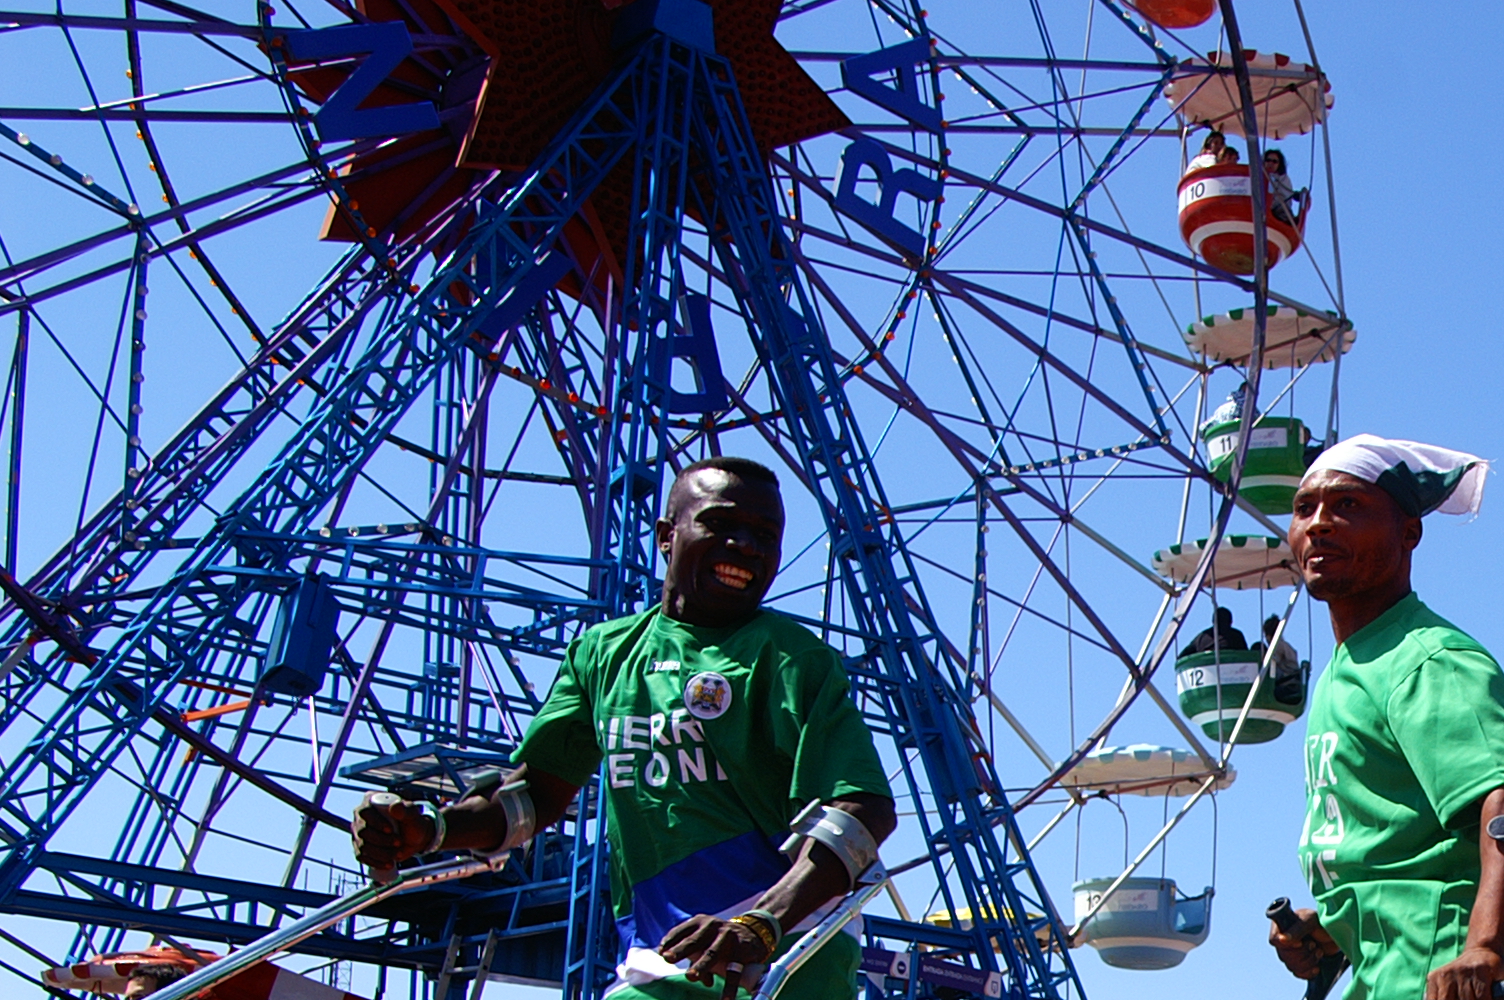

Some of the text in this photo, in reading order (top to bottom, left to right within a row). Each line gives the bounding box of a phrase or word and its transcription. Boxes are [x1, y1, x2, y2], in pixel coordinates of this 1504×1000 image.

[1190, 182, 1205, 200] 10
[1220, 435, 1232, 453] 11
[1189, 669, 1204, 686] 12
[599, 708, 705, 750] IERR
